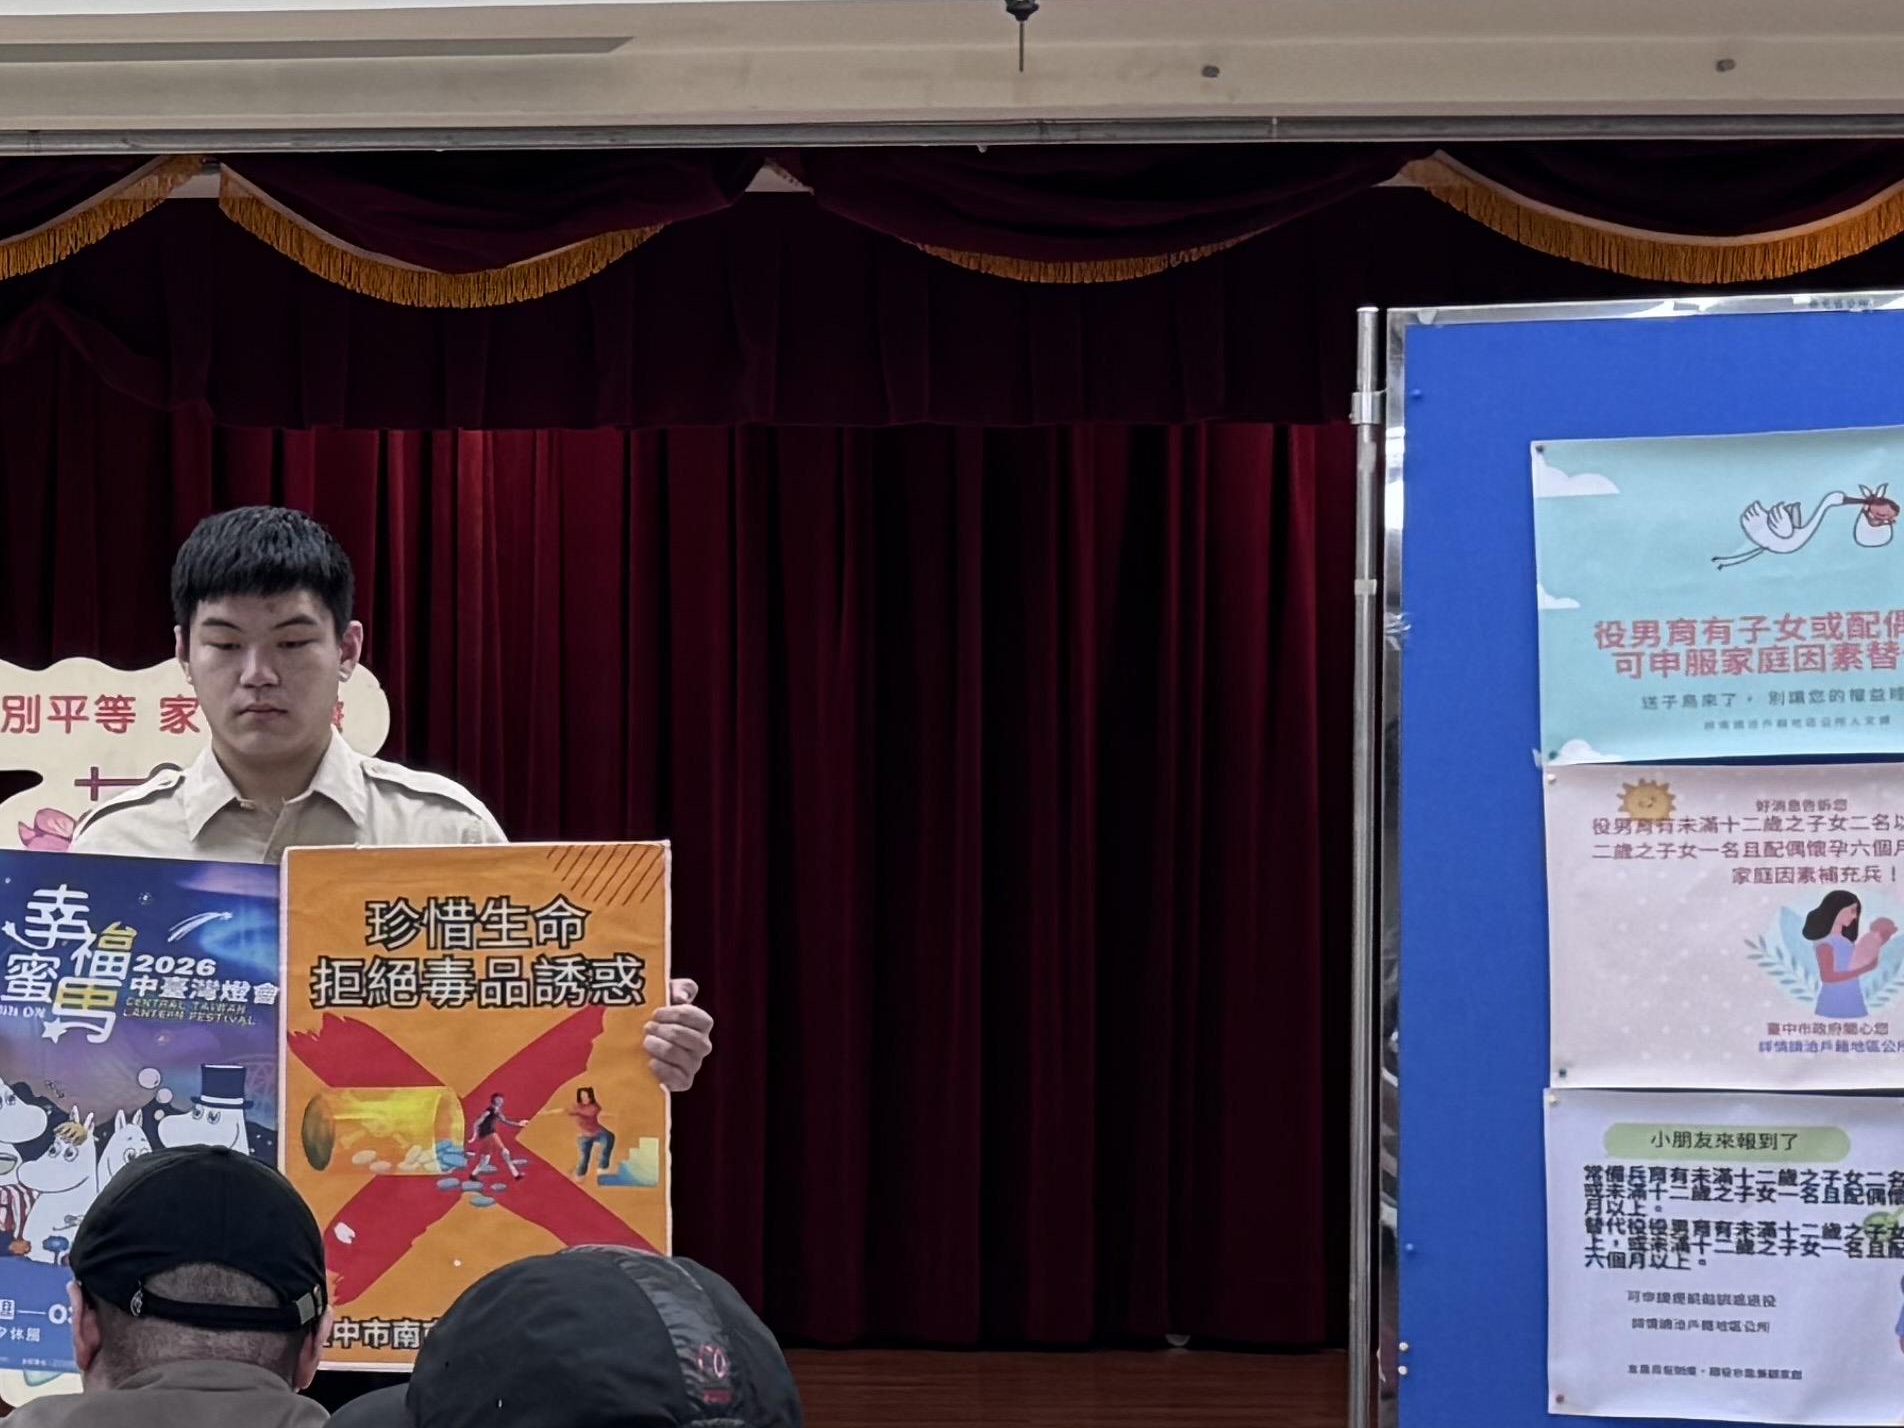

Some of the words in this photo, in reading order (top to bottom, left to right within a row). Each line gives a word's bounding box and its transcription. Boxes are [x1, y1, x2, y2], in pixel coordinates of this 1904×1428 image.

[365, 893, 592, 951] 珍惜生命
[132, 955, 217, 976] 2026
[310, 953, 646, 1009] 拒絕毒品誘惑
[130, 974, 279, 1006] 中臺灣燈會
[1650, 1130, 1799, 1151] 小朋友來報到了
[323, 1316, 439, 1349] 中市南
